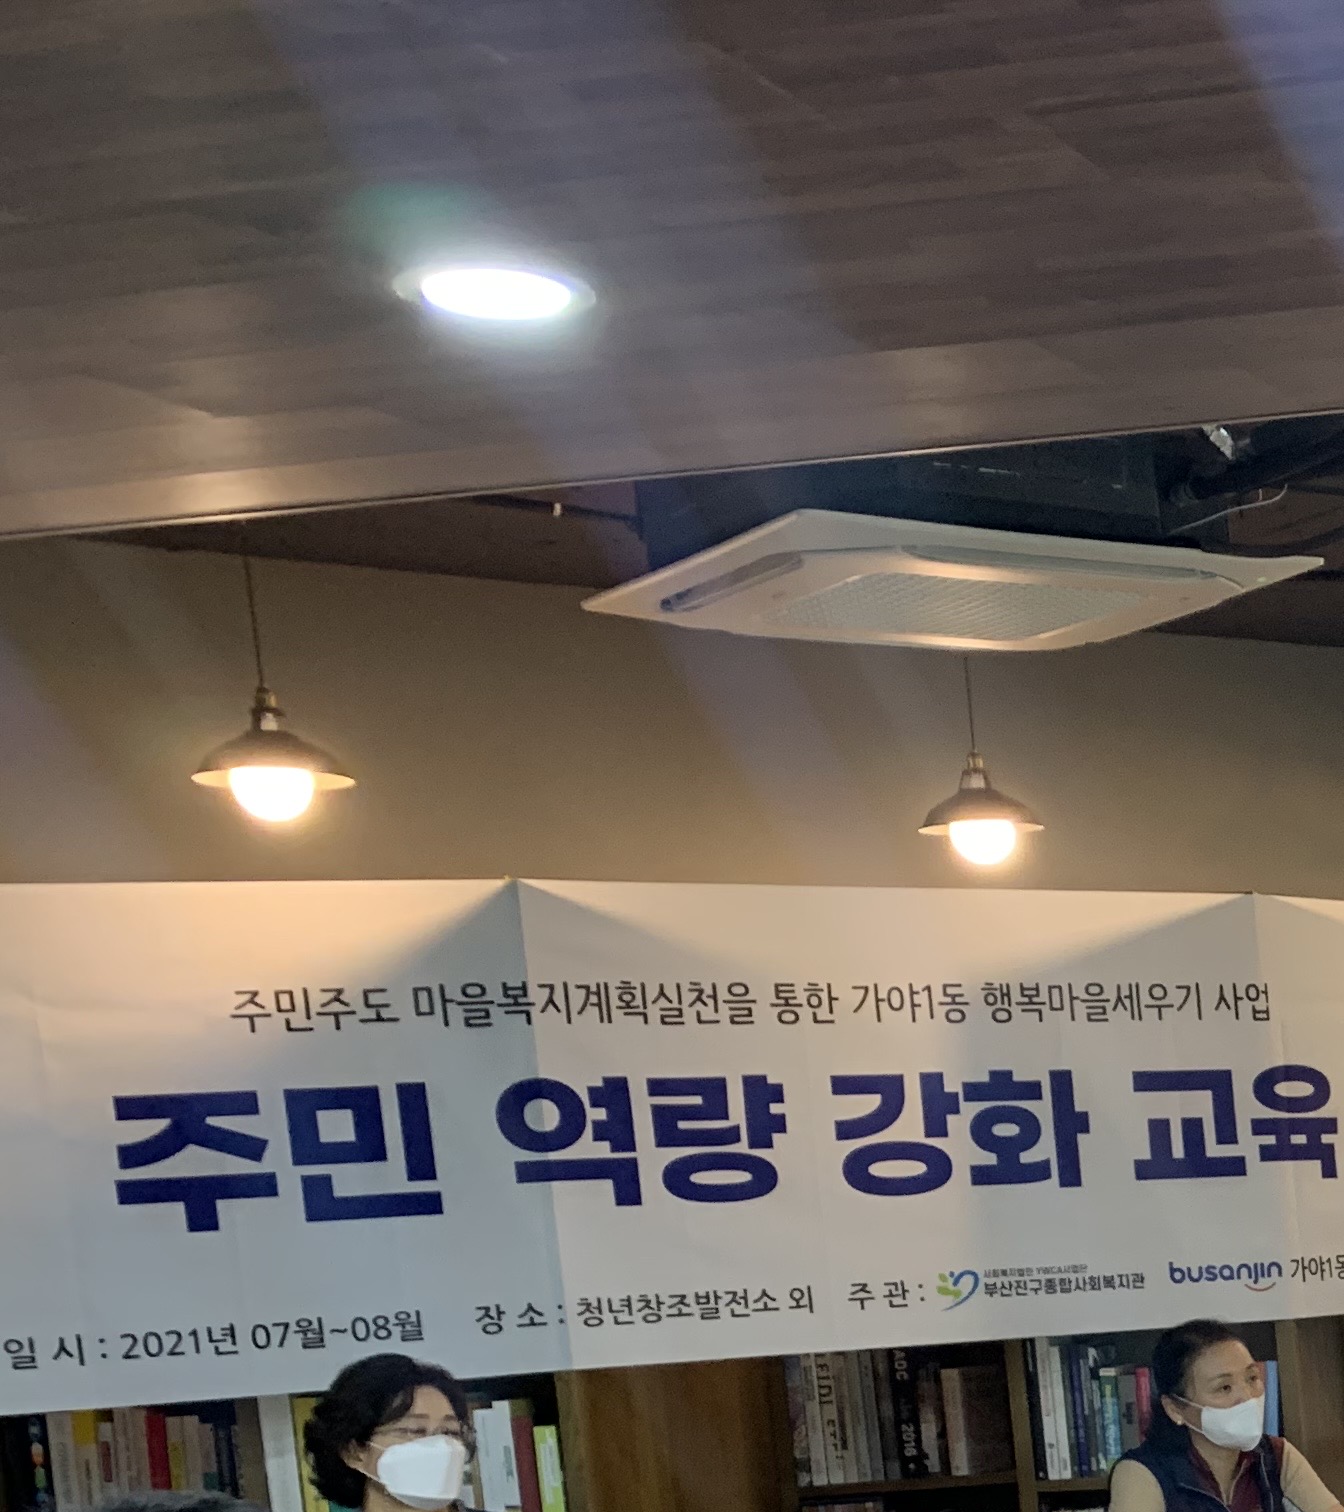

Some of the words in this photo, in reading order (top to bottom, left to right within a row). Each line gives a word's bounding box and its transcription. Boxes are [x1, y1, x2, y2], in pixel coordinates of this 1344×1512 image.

[229, 986, 400, 1033] 주민주도
[412, 979, 758, 1029] 마을복지계획실천을
[769, 981, 839, 1026] 통한
[851, 982, 971, 1025] 가야1동
[981, 981, 1203, 1025] 행복마을세우기
[1214, 981, 1271, 1022] 사업
[112, 1080, 444, 1233] 주민
[494, 1073, 788, 1207] 역량
[830, 1068, 1091, 1197] 강화
[1131, 1063, 1339, 1182] 교육
[984, 1272, 1145, 1298] 부산진구종합사회복지관
[1168, 1260, 1284, 1286] busanjin
[576, 1288, 781, 1327] 청년창조발전소
[788, 1285, 815, 1314] 외
[120, 1322, 240, 1362] 2021년
[250, 1309, 425, 1351] 07월~08월
